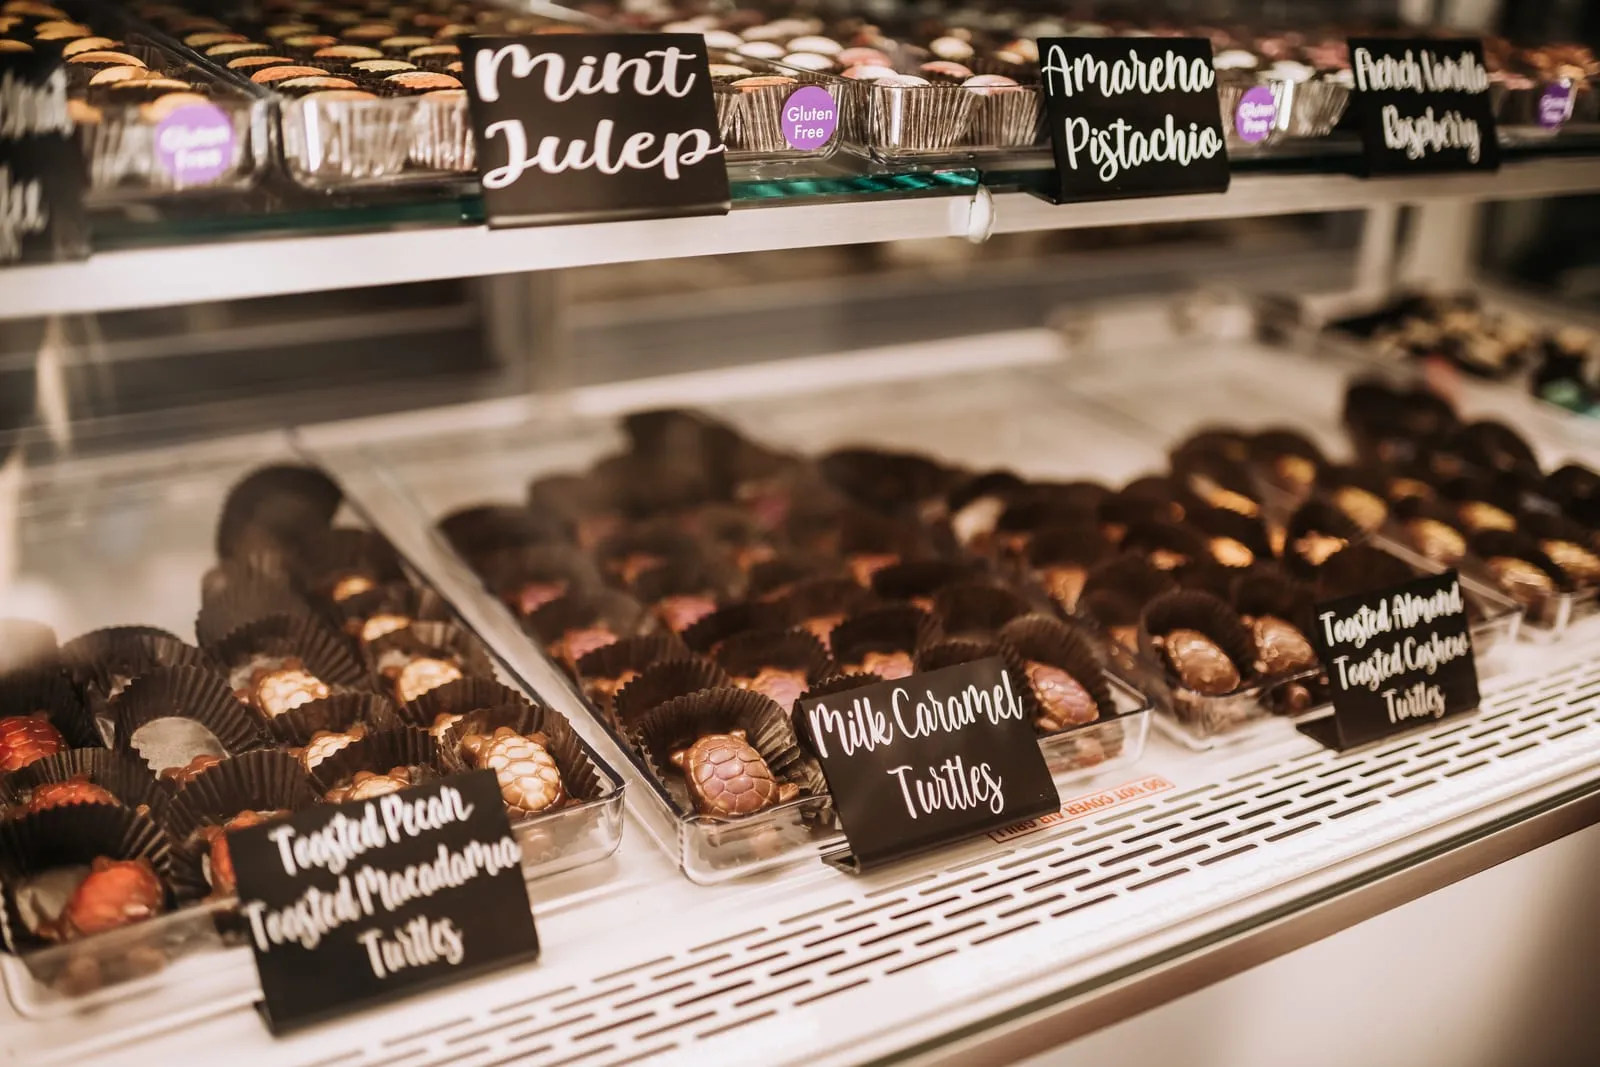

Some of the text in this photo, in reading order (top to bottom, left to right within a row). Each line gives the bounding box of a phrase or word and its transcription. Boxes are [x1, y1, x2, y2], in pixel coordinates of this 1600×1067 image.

[475, 43, 697, 102] Mint
[1041, 44, 1215, 97] Amarena
[787, 106, 833, 123] Gluten
[794, 125, 824, 140] Free
[482, 118, 728, 189] Julep
[1065, 113, 1222, 182] Pistachio
[1319, 580, 1464, 649] Toasted Almond
[1333, 631, 1471, 691] Toasted Cashew
[808, 669, 1023, 759] Milk Caramel
[1381, 681, 1446, 724] Turtles
[887, 754, 1004, 820] Turtles
[1063, 793, 1115, 815] COVER
[1117, 786, 1147, 802] NOT
[268, 785, 475, 877] Toasted Pecan
[241, 836, 523, 953] Toasted Macadamia
[357, 914, 465, 980] Turtles
